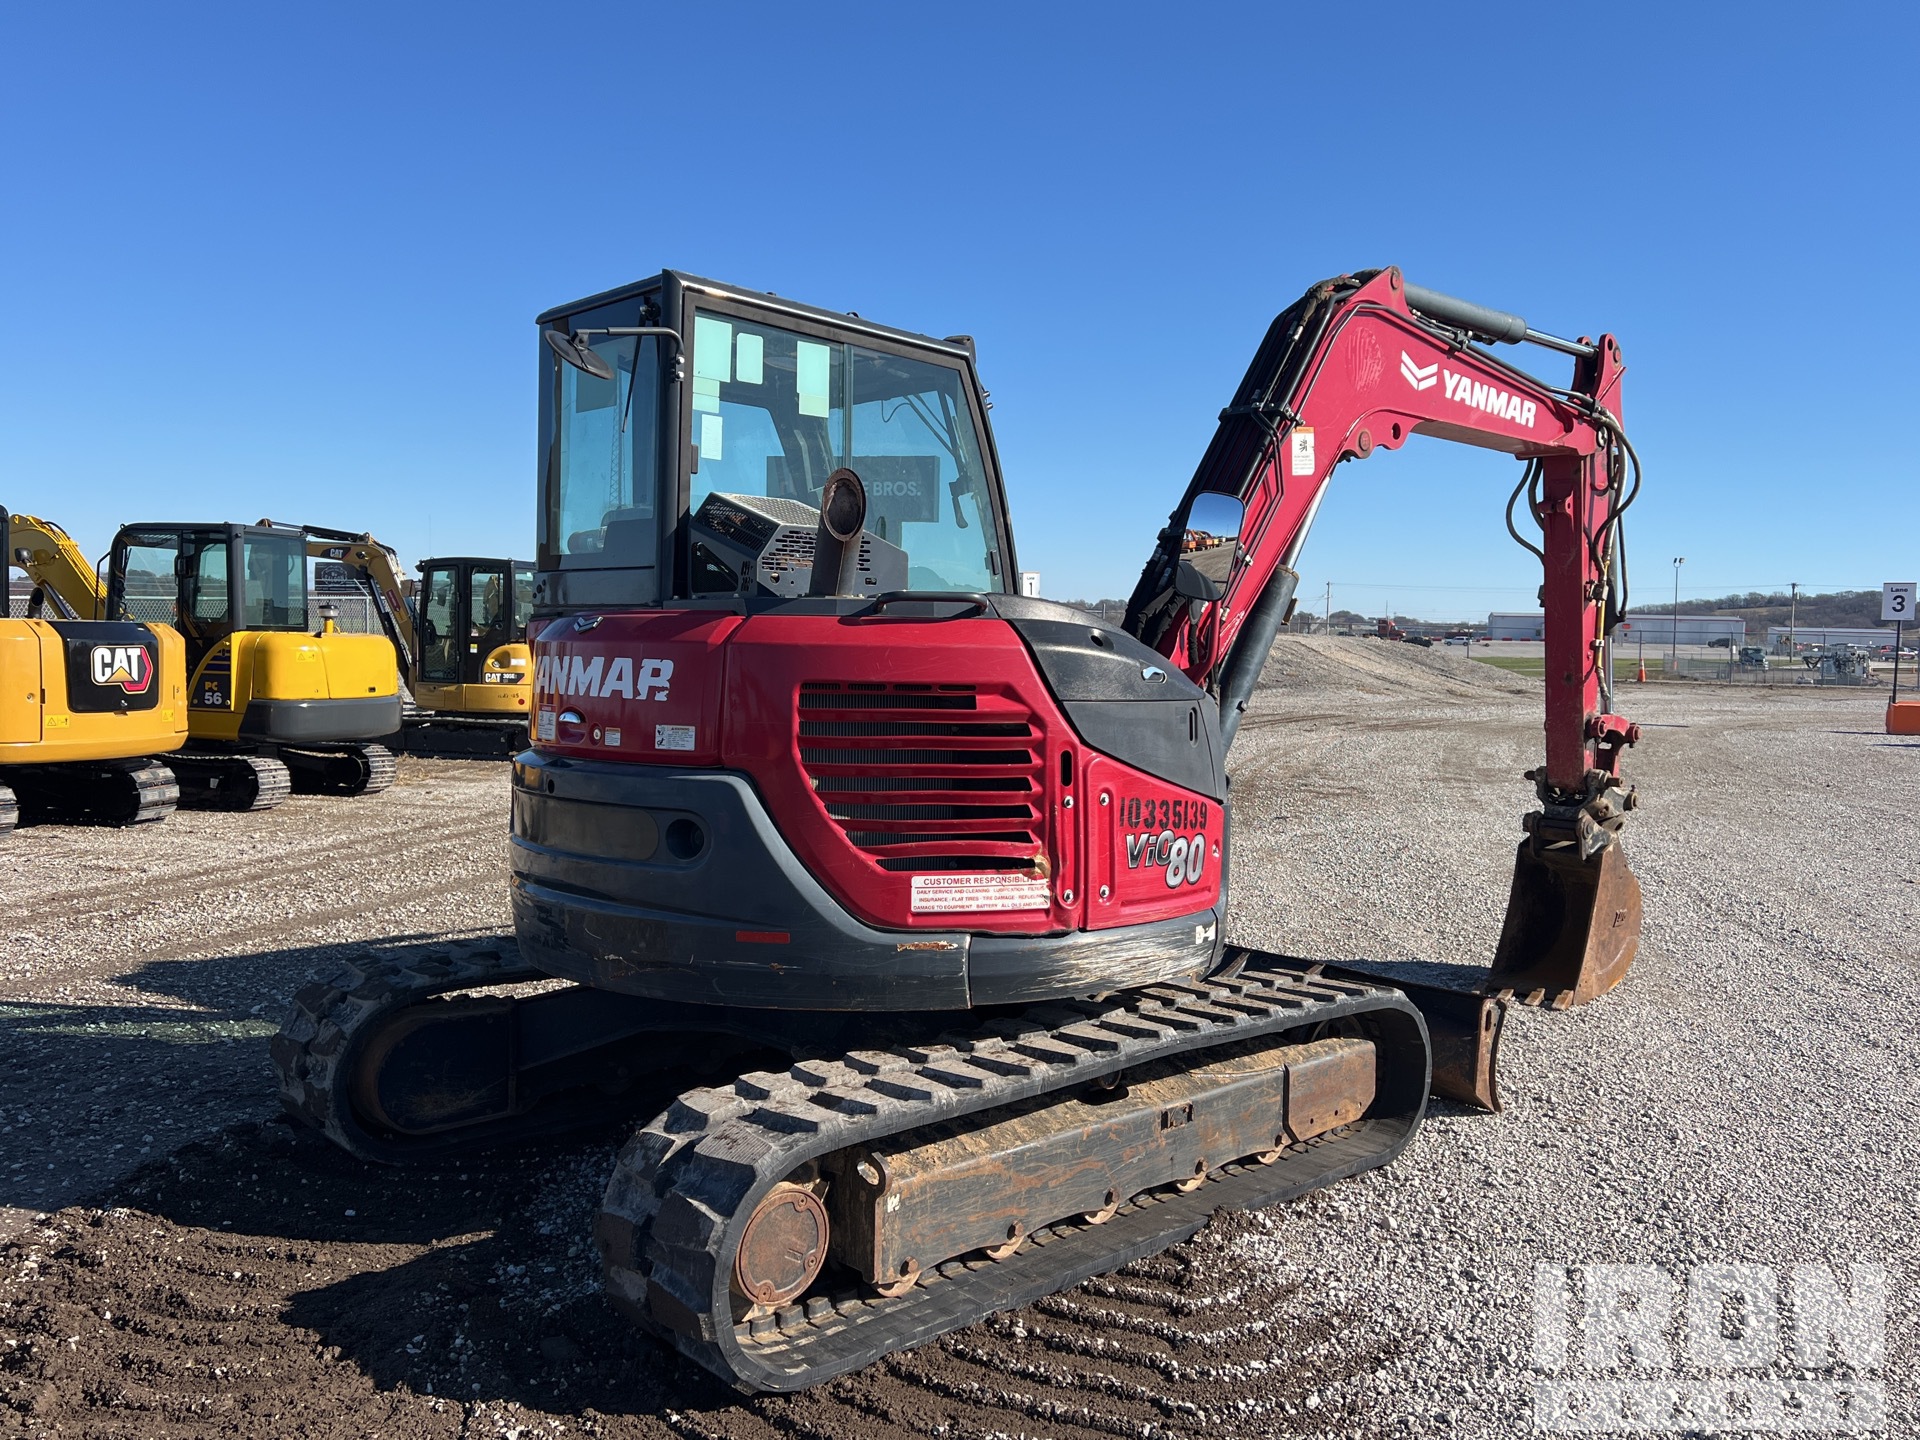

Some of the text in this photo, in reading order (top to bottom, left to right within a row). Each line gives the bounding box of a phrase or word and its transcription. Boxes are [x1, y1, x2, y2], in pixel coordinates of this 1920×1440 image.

[1443, 369, 1537, 429] YANMAR
[872, 480, 922, 497] BROS.
[329, 548, 343, 558] CAT
[1028, 581, 1033, 596] 1
[1892, 594, 1906, 613] 3
[93, 647, 141, 683] CAT
[204, 681, 218, 691] PC
[485, 673, 501, 683] CAT
[204, 691, 222, 705] 56
[1119, 797, 1208, 831] 10335139
[1165, 833, 1206, 889] 80
[923, 877, 972, 886] CUSTOMER
